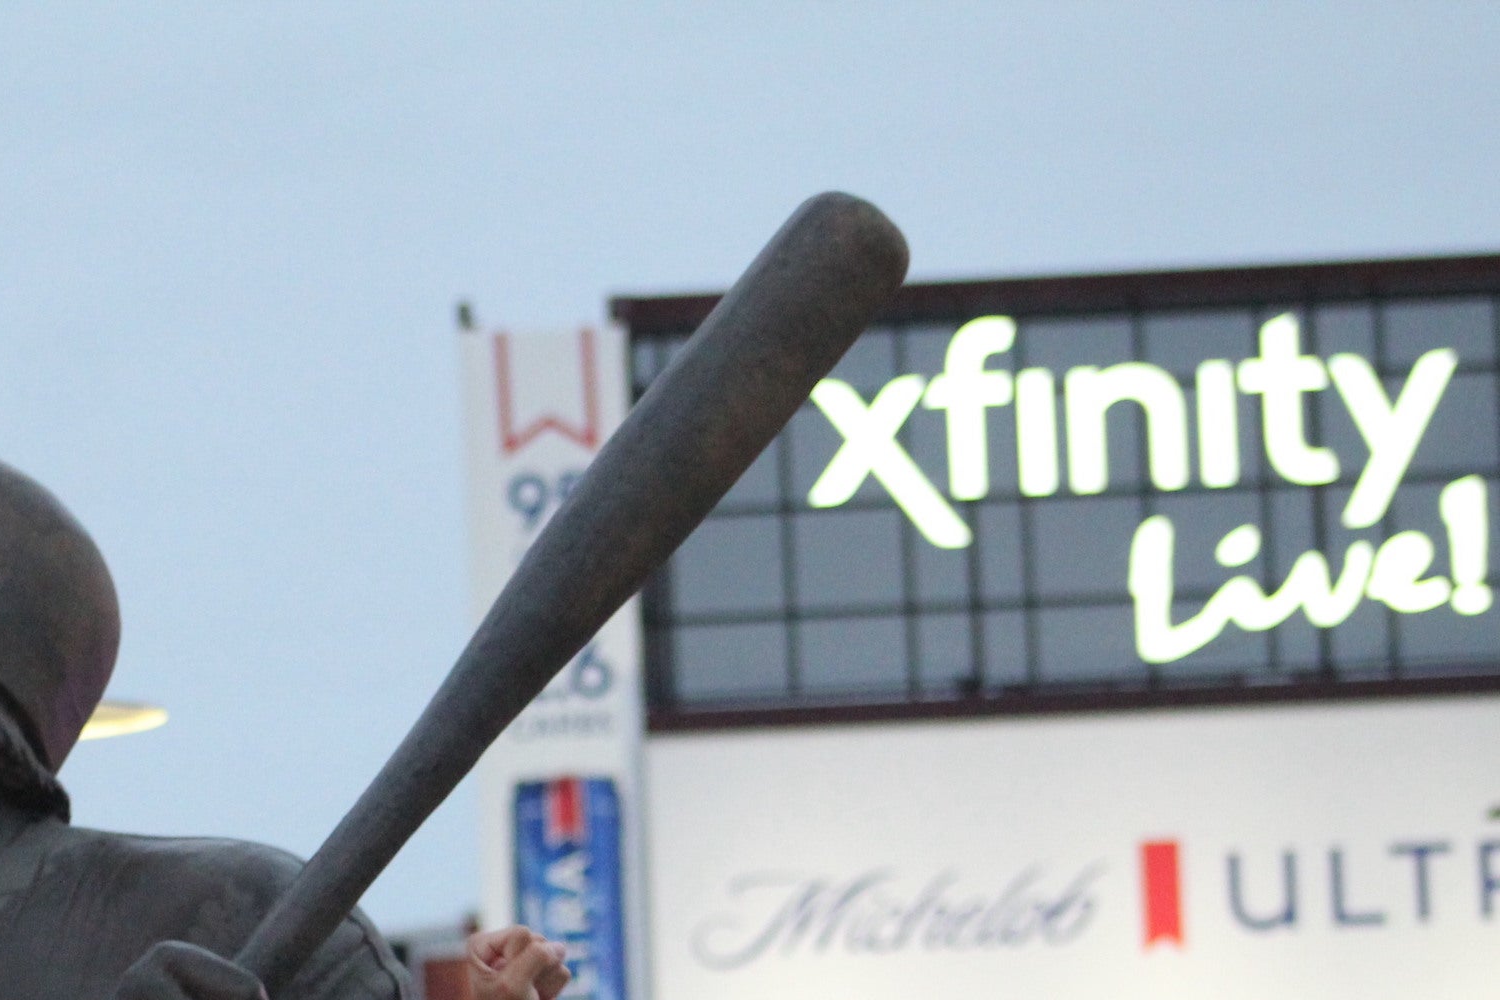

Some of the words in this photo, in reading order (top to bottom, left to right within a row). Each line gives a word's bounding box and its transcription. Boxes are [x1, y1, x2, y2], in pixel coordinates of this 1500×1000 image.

[807, 312, 1459, 549] xfinity
[1128, 473, 1493, 664] Live!
[688, 858, 1110, 972] Michelob
